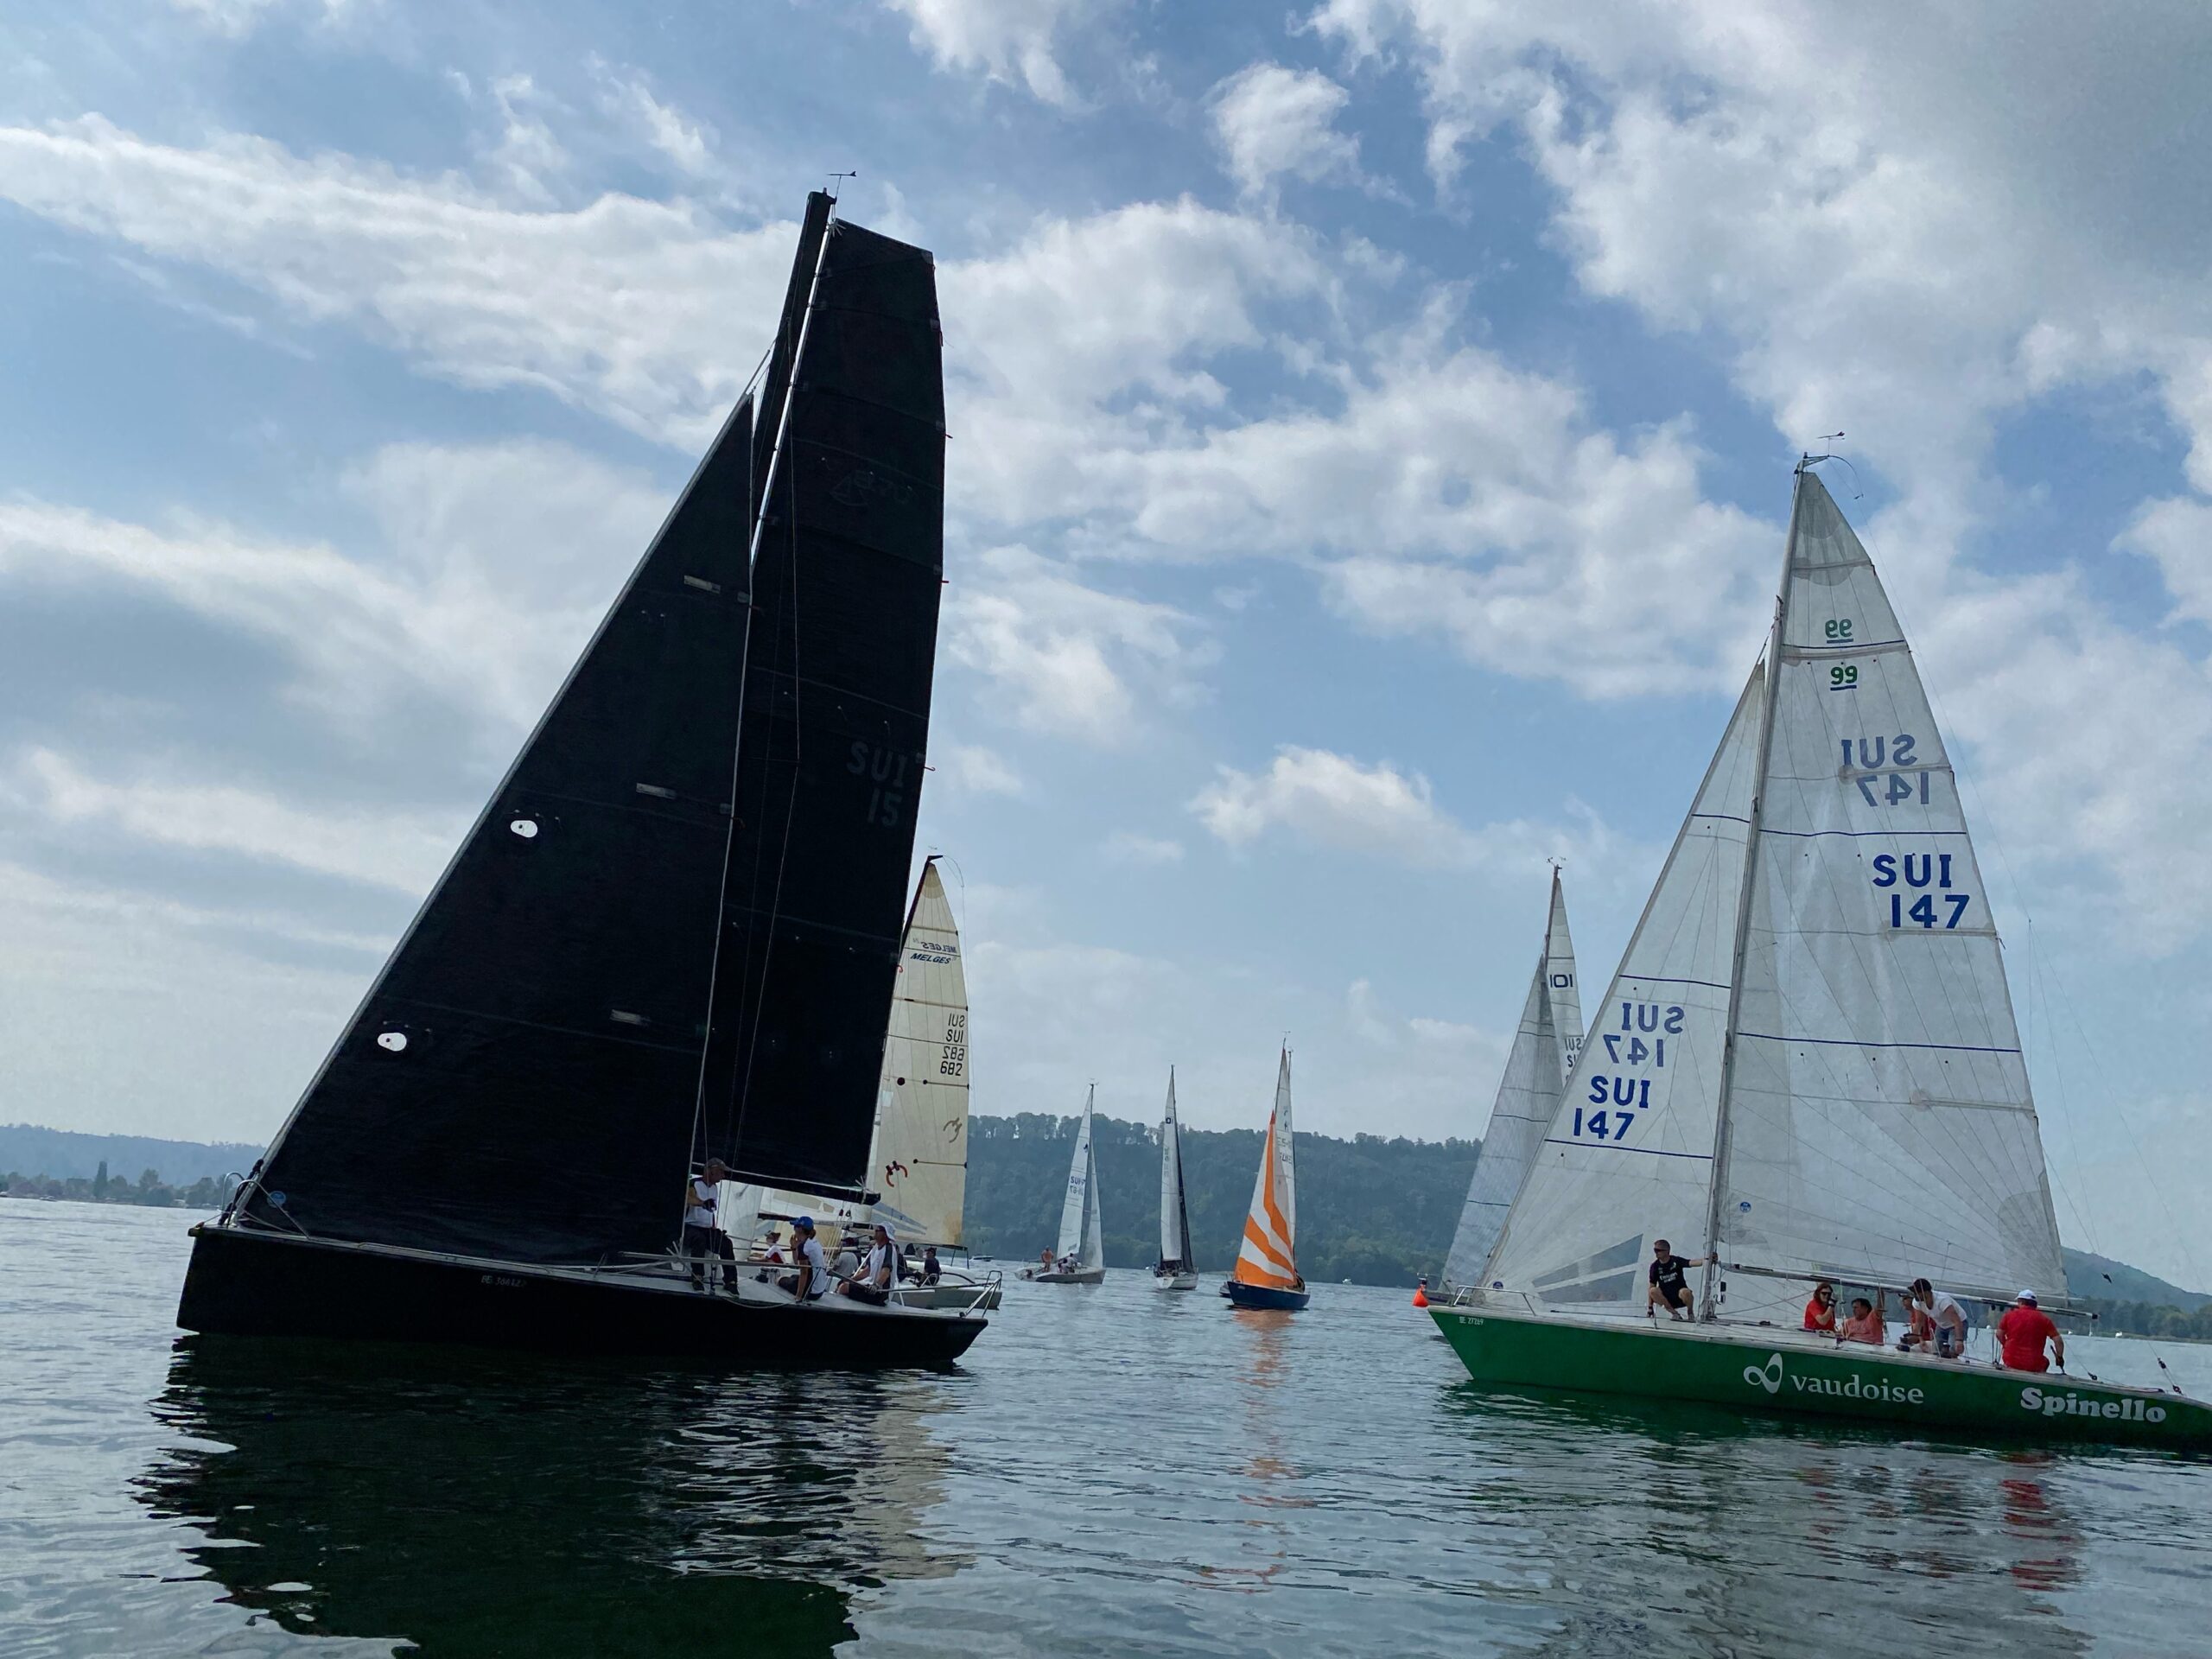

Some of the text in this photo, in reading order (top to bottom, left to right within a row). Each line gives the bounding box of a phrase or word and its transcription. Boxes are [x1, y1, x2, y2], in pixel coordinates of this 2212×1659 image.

[1830, 665, 1858, 685] 99
[847, 741, 907, 787] SUI
[867, 787, 902, 827] 15
[1872, 854, 1952, 888] SUI
[1891, 894, 1970, 929] 147
[911, 953, 951, 964] MELGES
[945, 1029, 963, 1043] SUI
[940, 1061, 963, 1076] 682
[1588, 1076, 1650, 1109] SUI
[1573, 1108, 1635, 1140] 147
[1790, 1374, 1924, 1404] vaudoise
[2019, 1387, 2167, 1423] Spinello
